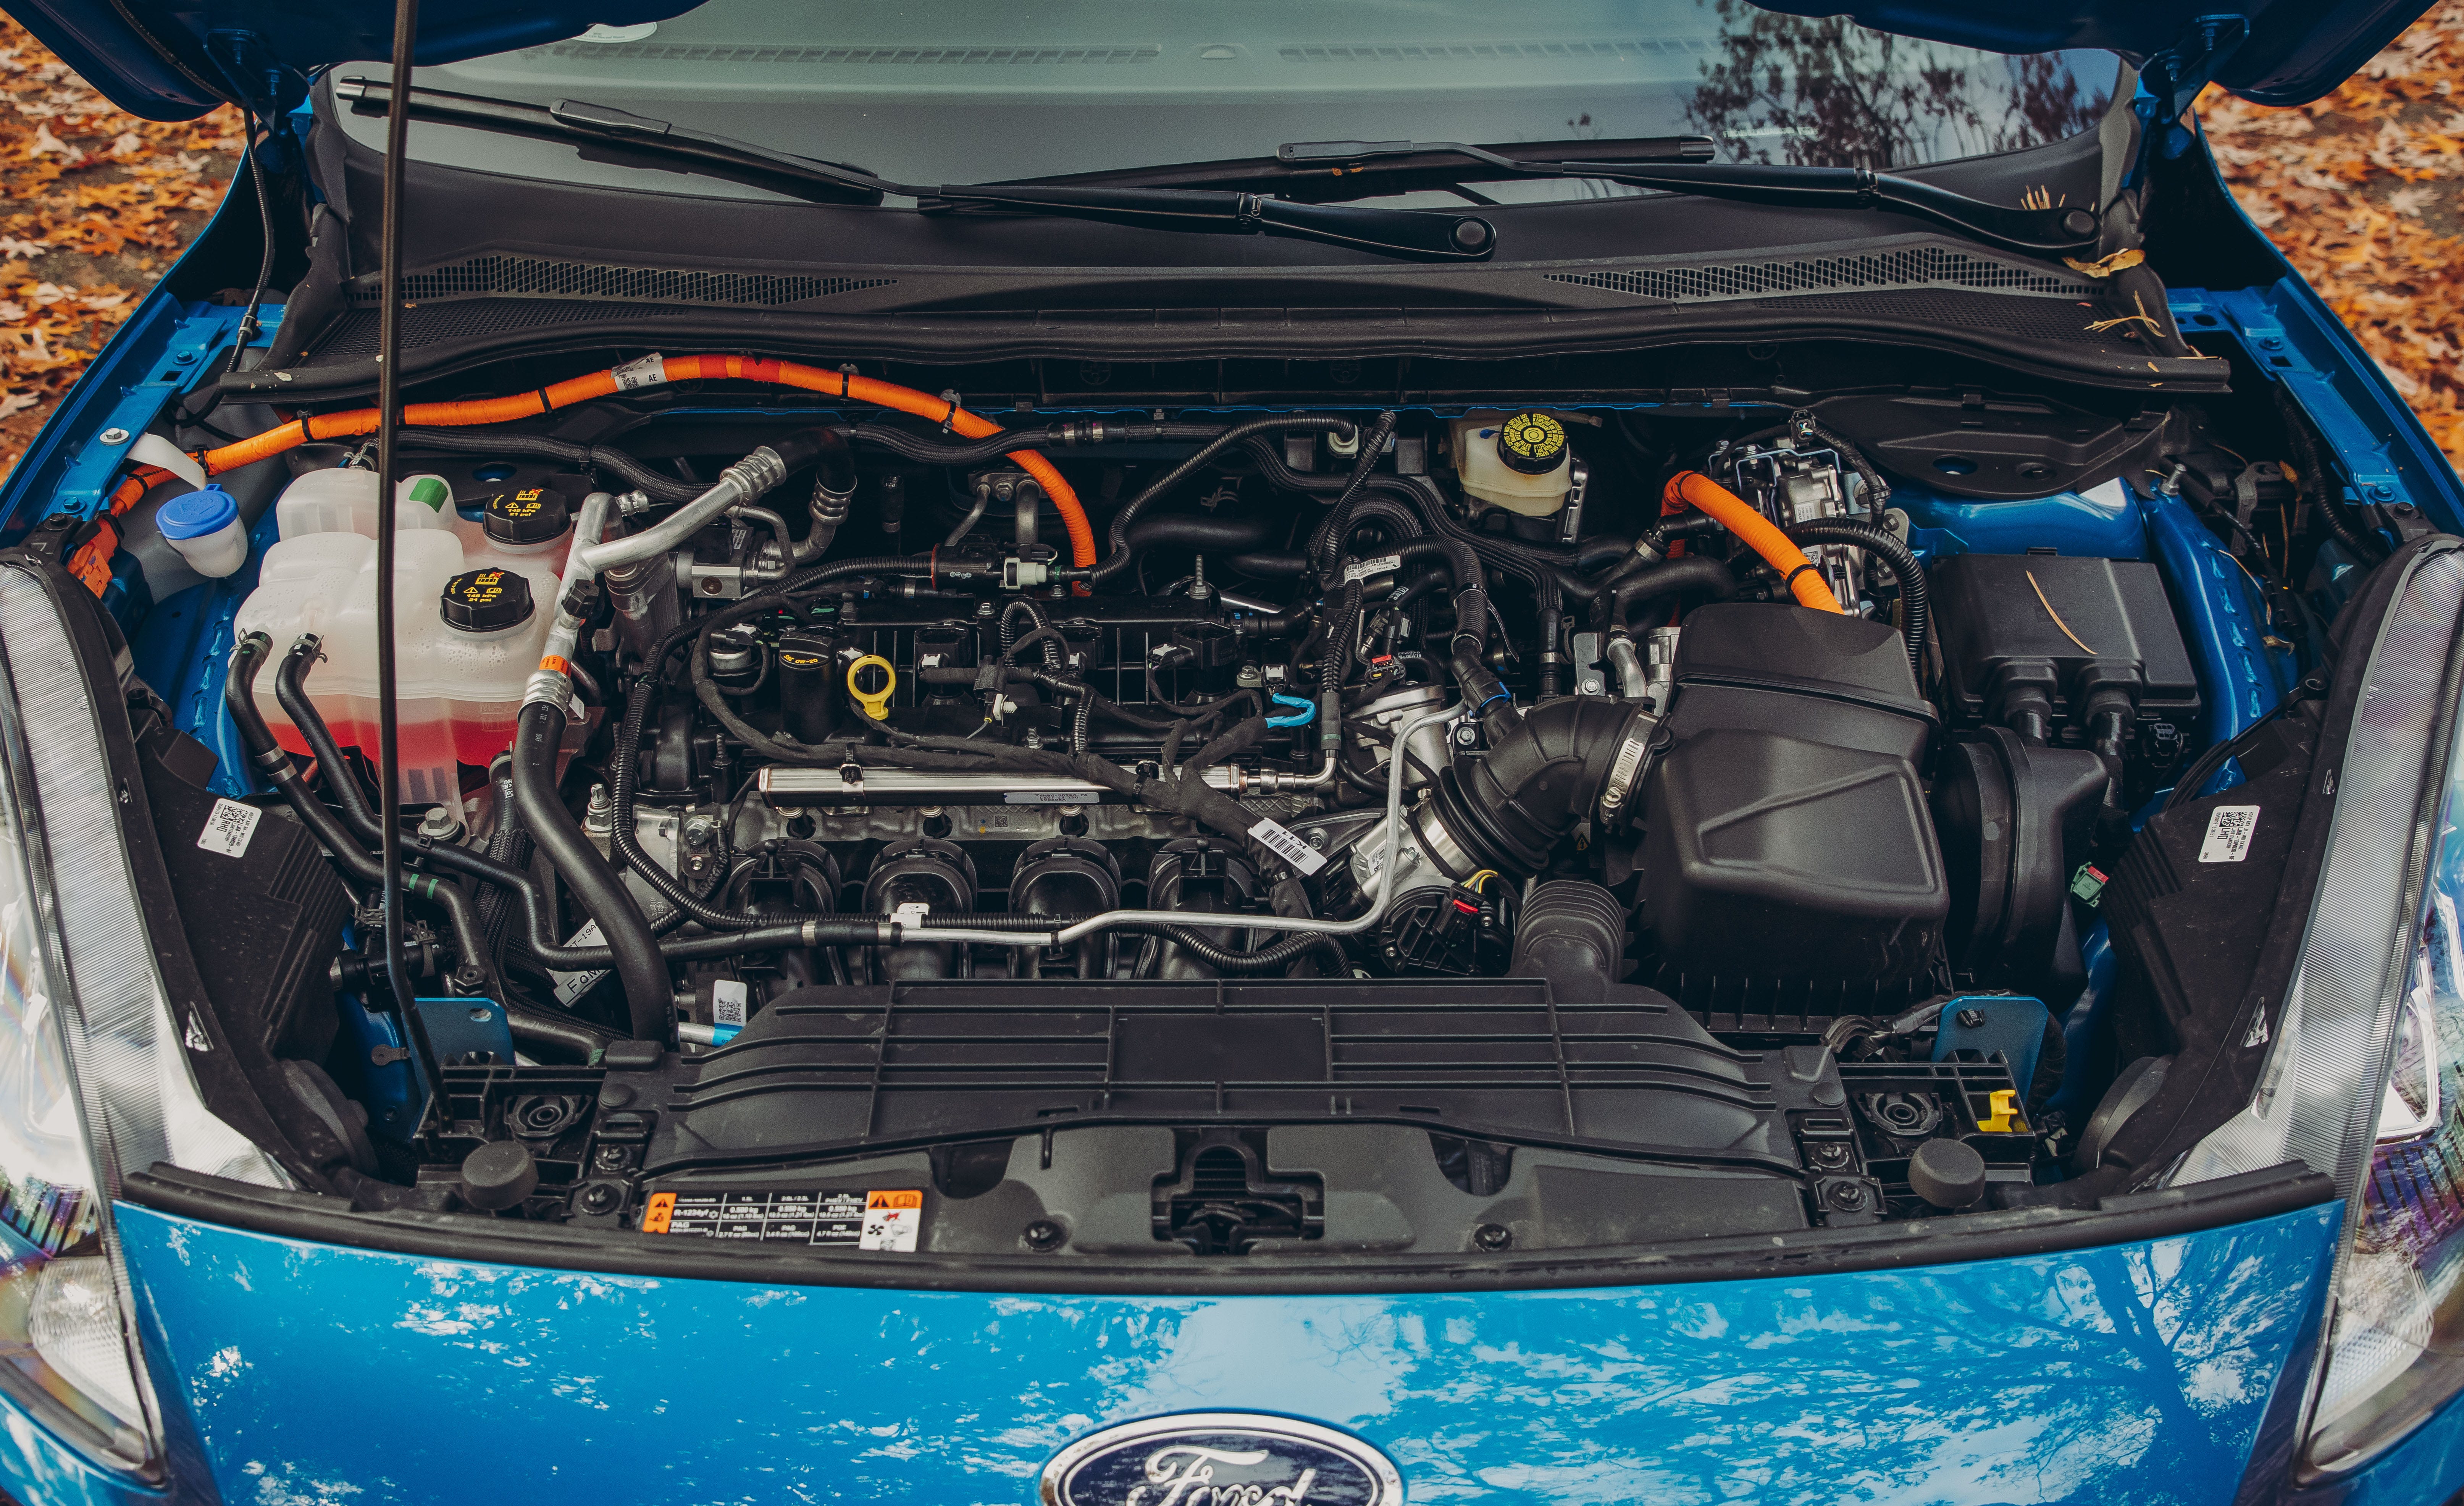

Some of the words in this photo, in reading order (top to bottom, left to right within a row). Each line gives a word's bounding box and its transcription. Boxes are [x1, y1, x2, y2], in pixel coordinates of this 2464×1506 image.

[649, 373, 657, 382] AE
[1511, 445, 1530, 456] CONTAINER
[1351, 569, 1373, 577] AUTOMOTIVE
[1282, 831, 1307, 849] K11
[674, 1209, 709, 1217] R-1234yf
